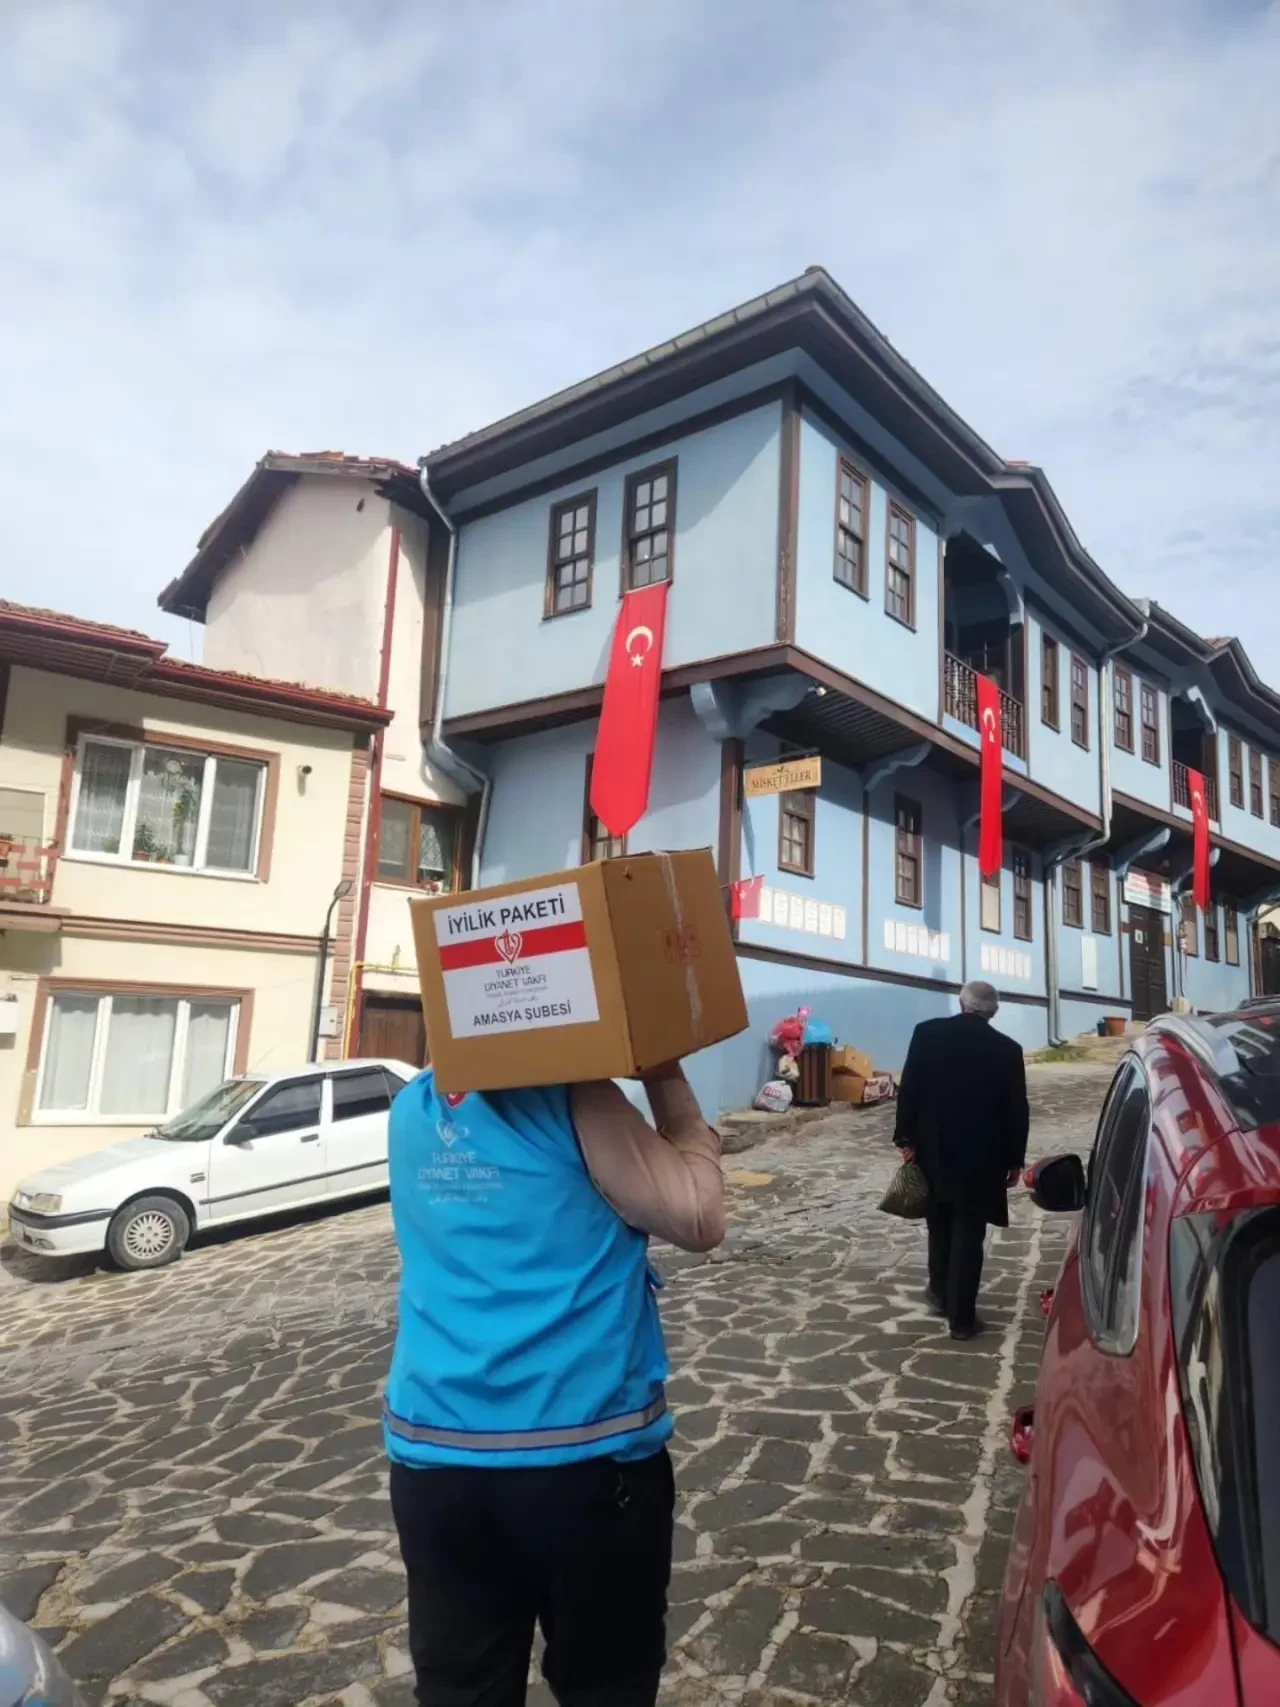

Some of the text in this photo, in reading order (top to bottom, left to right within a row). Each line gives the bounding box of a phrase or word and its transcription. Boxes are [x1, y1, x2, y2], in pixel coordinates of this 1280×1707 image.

[447, 892, 566, 935] İYİLİK PAKETİ
[473, 1010, 523, 1027] AMASYA
[524, 999, 573, 1023] ŞUBESİ
